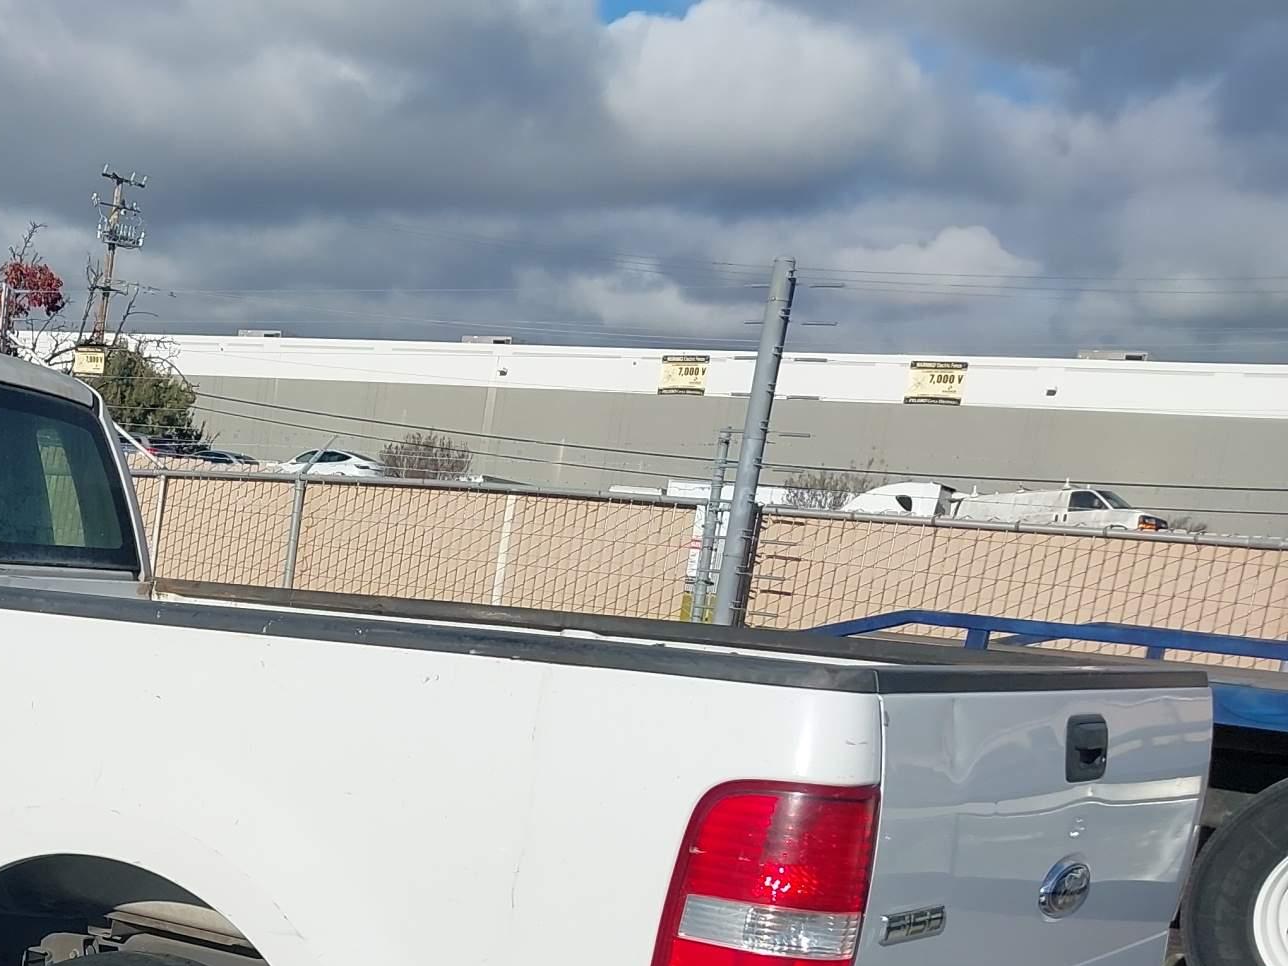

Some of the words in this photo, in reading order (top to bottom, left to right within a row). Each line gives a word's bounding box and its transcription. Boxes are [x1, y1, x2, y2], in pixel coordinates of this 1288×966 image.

[678, 367, 700, 376] 7,000
[701, 367, 707, 376] V
[929, 374, 955, 384] 7,000
[957, 374, 964, 384] V
